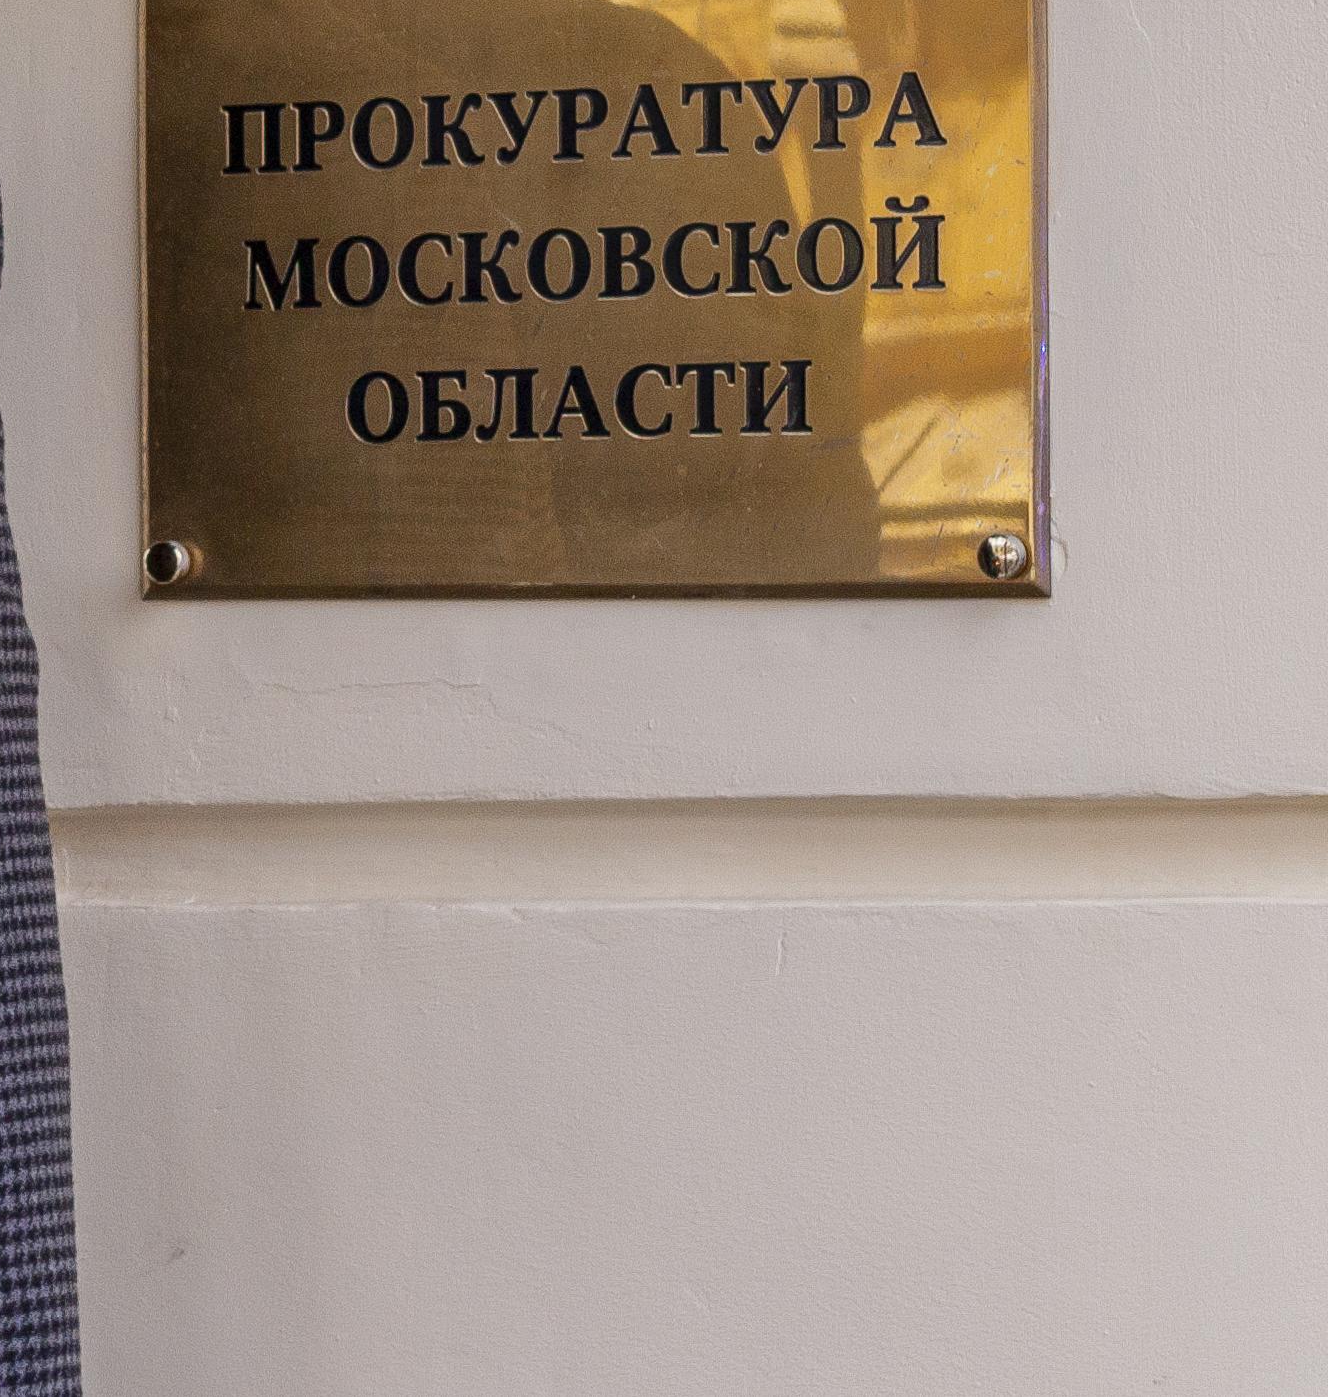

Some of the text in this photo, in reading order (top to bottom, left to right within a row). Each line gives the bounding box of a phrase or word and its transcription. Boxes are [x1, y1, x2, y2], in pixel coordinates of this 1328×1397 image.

[221, 71, 947, 176] ПРОКУРАТУРА
[243, 195, 946, 312] МОСКОВСКОЙ
[346, 359, 814, 444] ОБЛАСТИ
